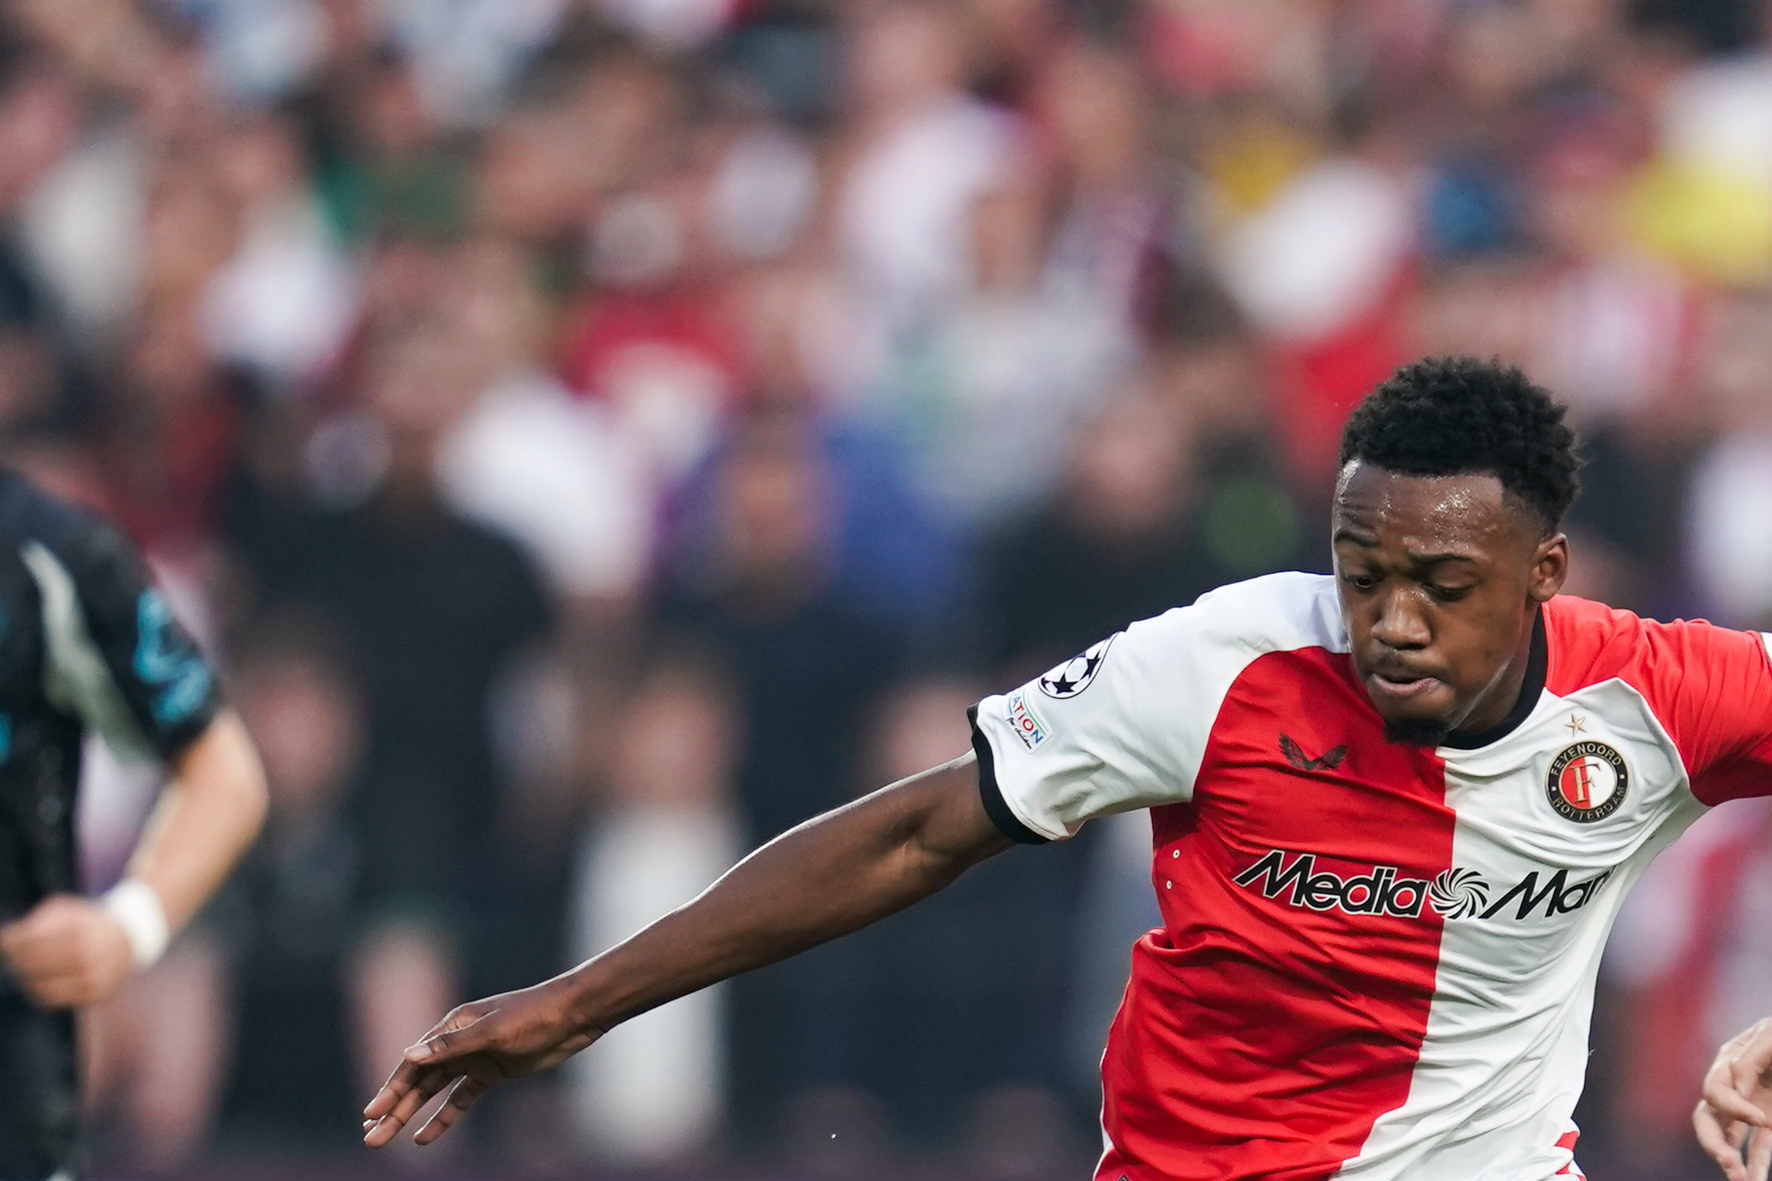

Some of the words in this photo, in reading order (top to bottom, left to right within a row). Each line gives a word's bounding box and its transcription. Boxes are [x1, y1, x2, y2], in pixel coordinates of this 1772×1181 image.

[1011, 694, 1043, 744] ATION
[1551, 743, 1622, 776] FEYENOORD
[1553, 786, 1625, 820] ROTTERDAM
[1233, 850, 1431, 918] Media
[1478, 867, 1619, 921] Mar
